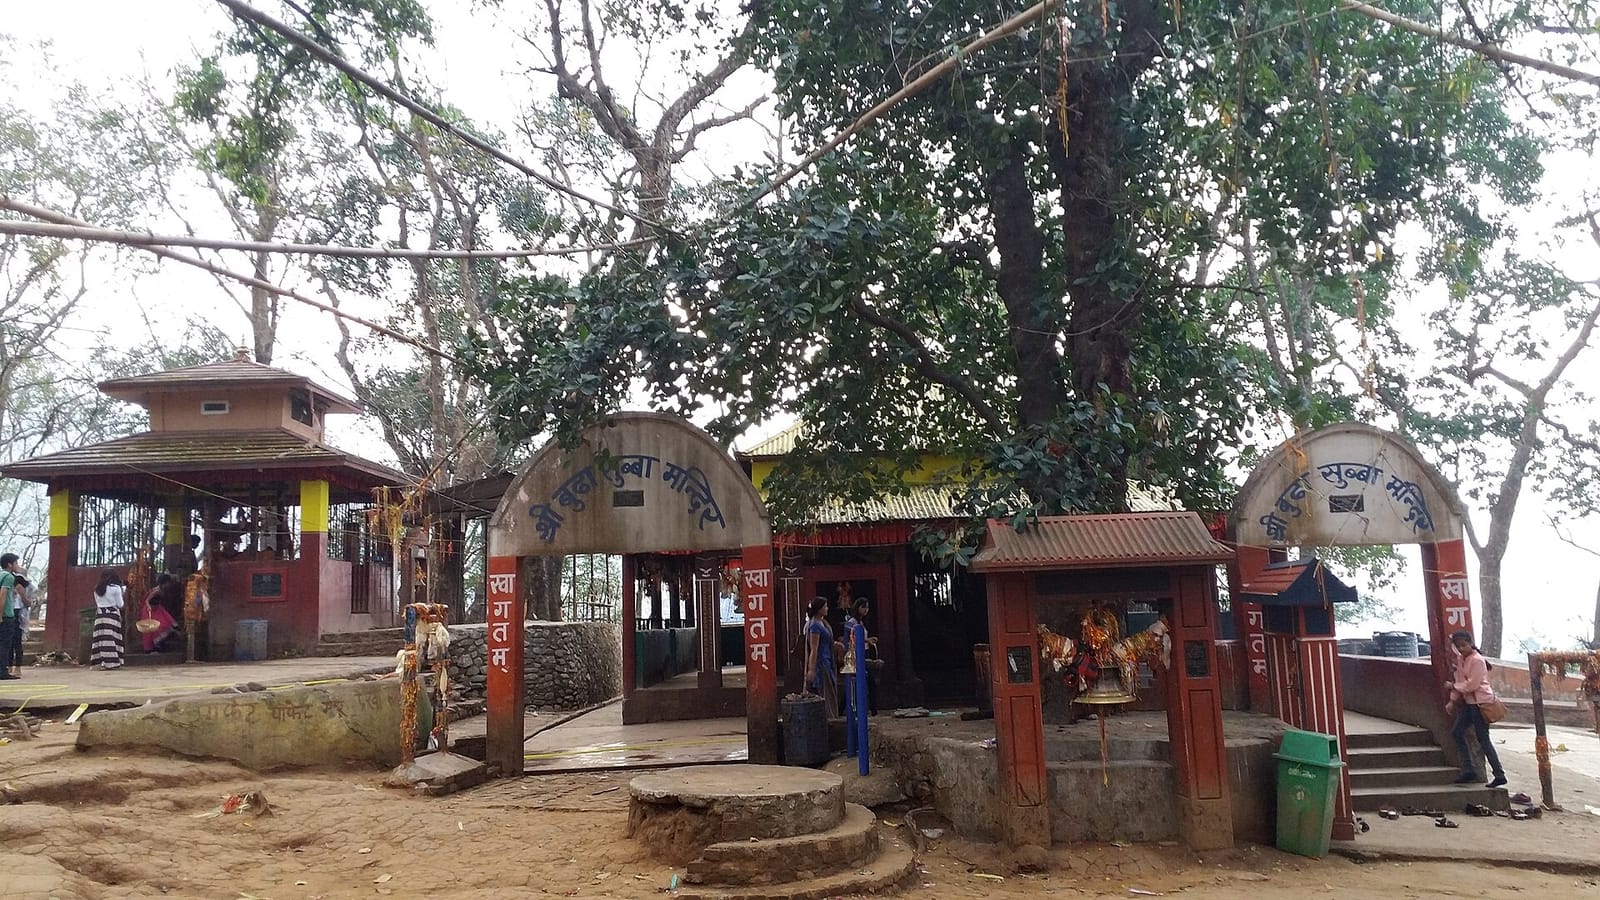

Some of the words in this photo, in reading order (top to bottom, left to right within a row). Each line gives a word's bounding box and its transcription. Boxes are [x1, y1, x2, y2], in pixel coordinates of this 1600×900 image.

[529, 504, 564, 544] श्री
[663, 462, 726, 531] मन्दिर
[1260, 512, 1288, 541] श्री
[1317, 462, 1384, 489] सुब्बा
[1386, 475, 1435, 535] मन्दिर
[489, 573, 516, 673] स्वागतम्
[743, 569, 771, 670] स्वागतम्
